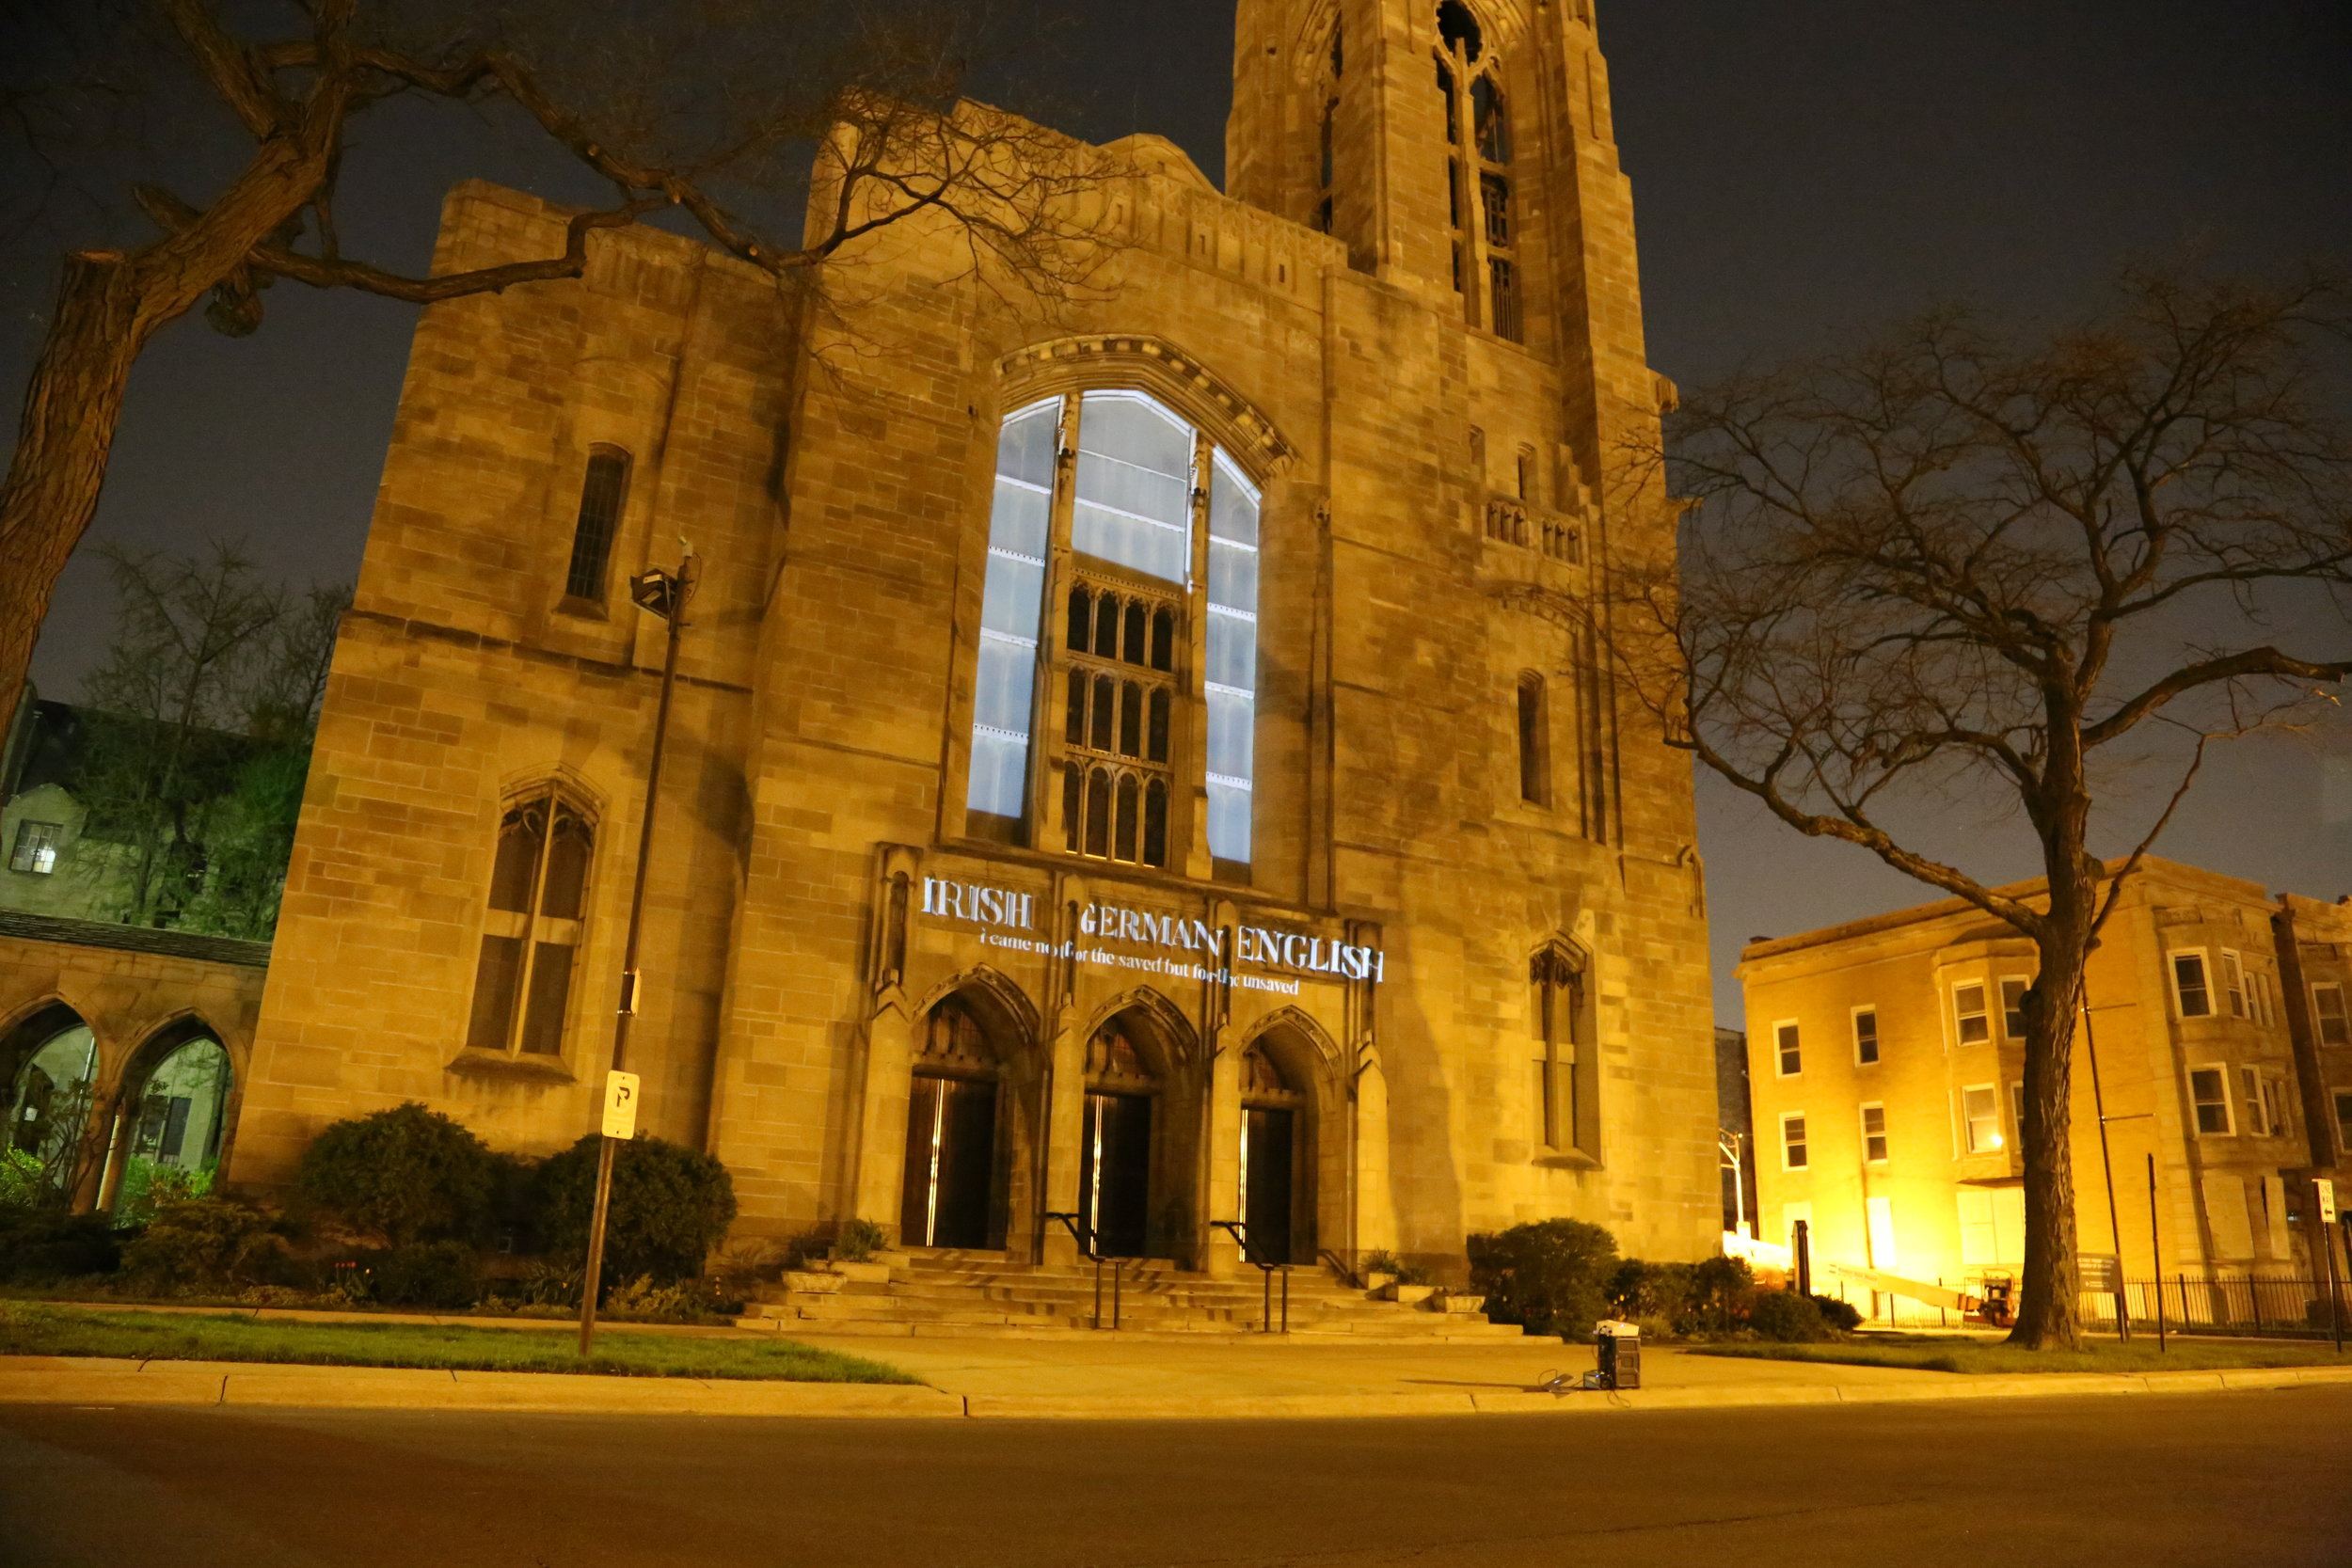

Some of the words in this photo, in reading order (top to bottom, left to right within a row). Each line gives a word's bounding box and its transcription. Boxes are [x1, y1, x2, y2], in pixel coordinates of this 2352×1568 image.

[921, 877, 1033, 929] IRISH
[1080, 903, 1223, 957] GERMAN
[1237, 926, 1384, 984] ENGLISH
[989, 934, 1032, 950] came
[1091, 946, 1115, 965] the
[1119, 955, 1162, 973] saved
[1165, 958, 1189, 977] but
[1243, 975, 1299, 996] unsaved
